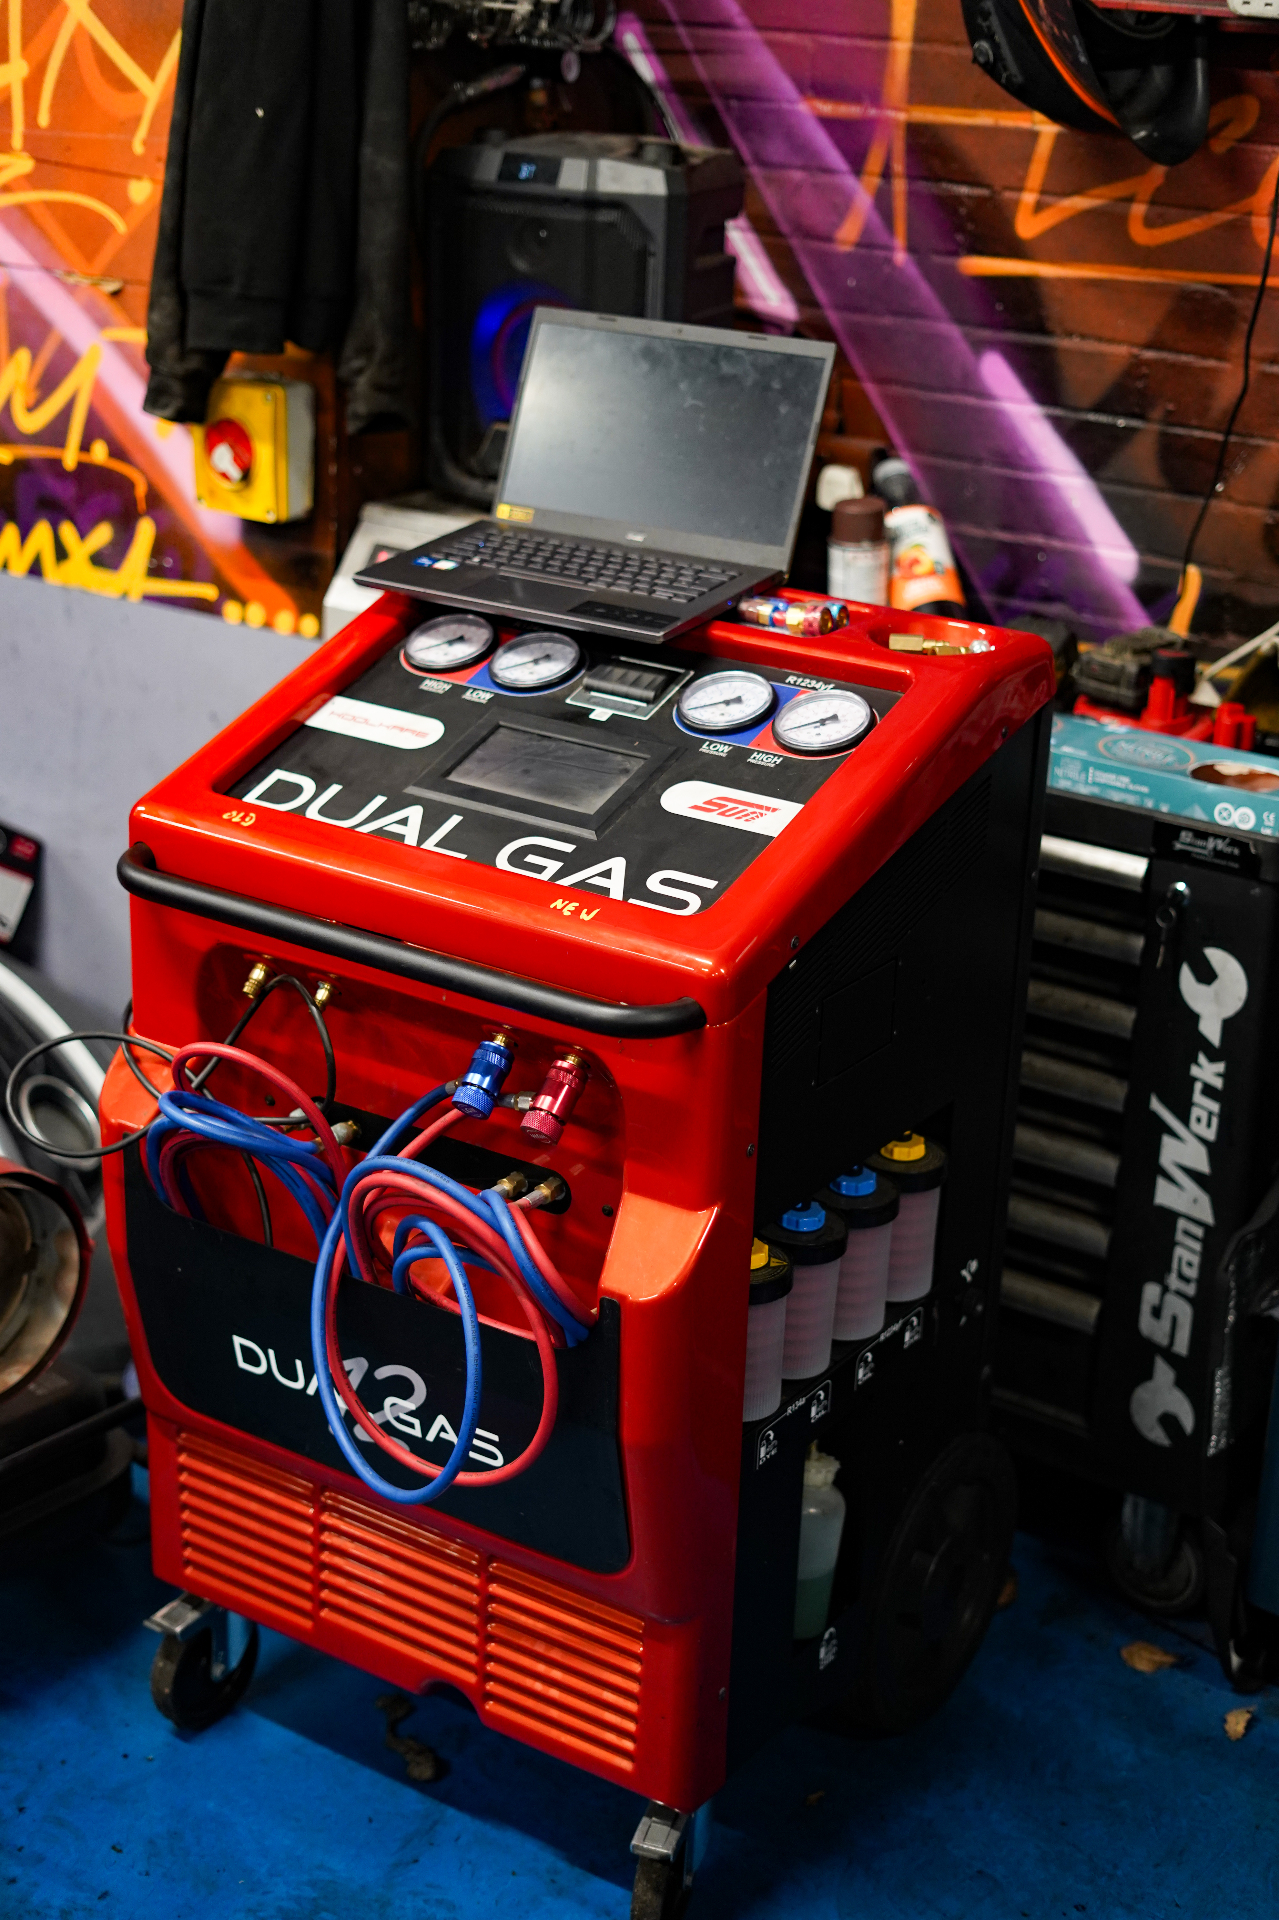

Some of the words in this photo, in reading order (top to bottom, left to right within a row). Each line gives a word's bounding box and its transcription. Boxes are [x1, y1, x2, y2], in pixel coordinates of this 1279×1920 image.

[420, 678, 453, 692] HIGH
[464, 688, 495, 701] LOW
[701, 741, 734, 753] LOW
[750, 751, 784, 765] HIGH
[241, 768, 468, 860] DUAL
[495, 835, 719, 916] GAS
[550, 898, 600, 921] NEW
[1137, 1050, 1227, 1358] StanWerk
[383, 1396, 503, 1468] GAS
